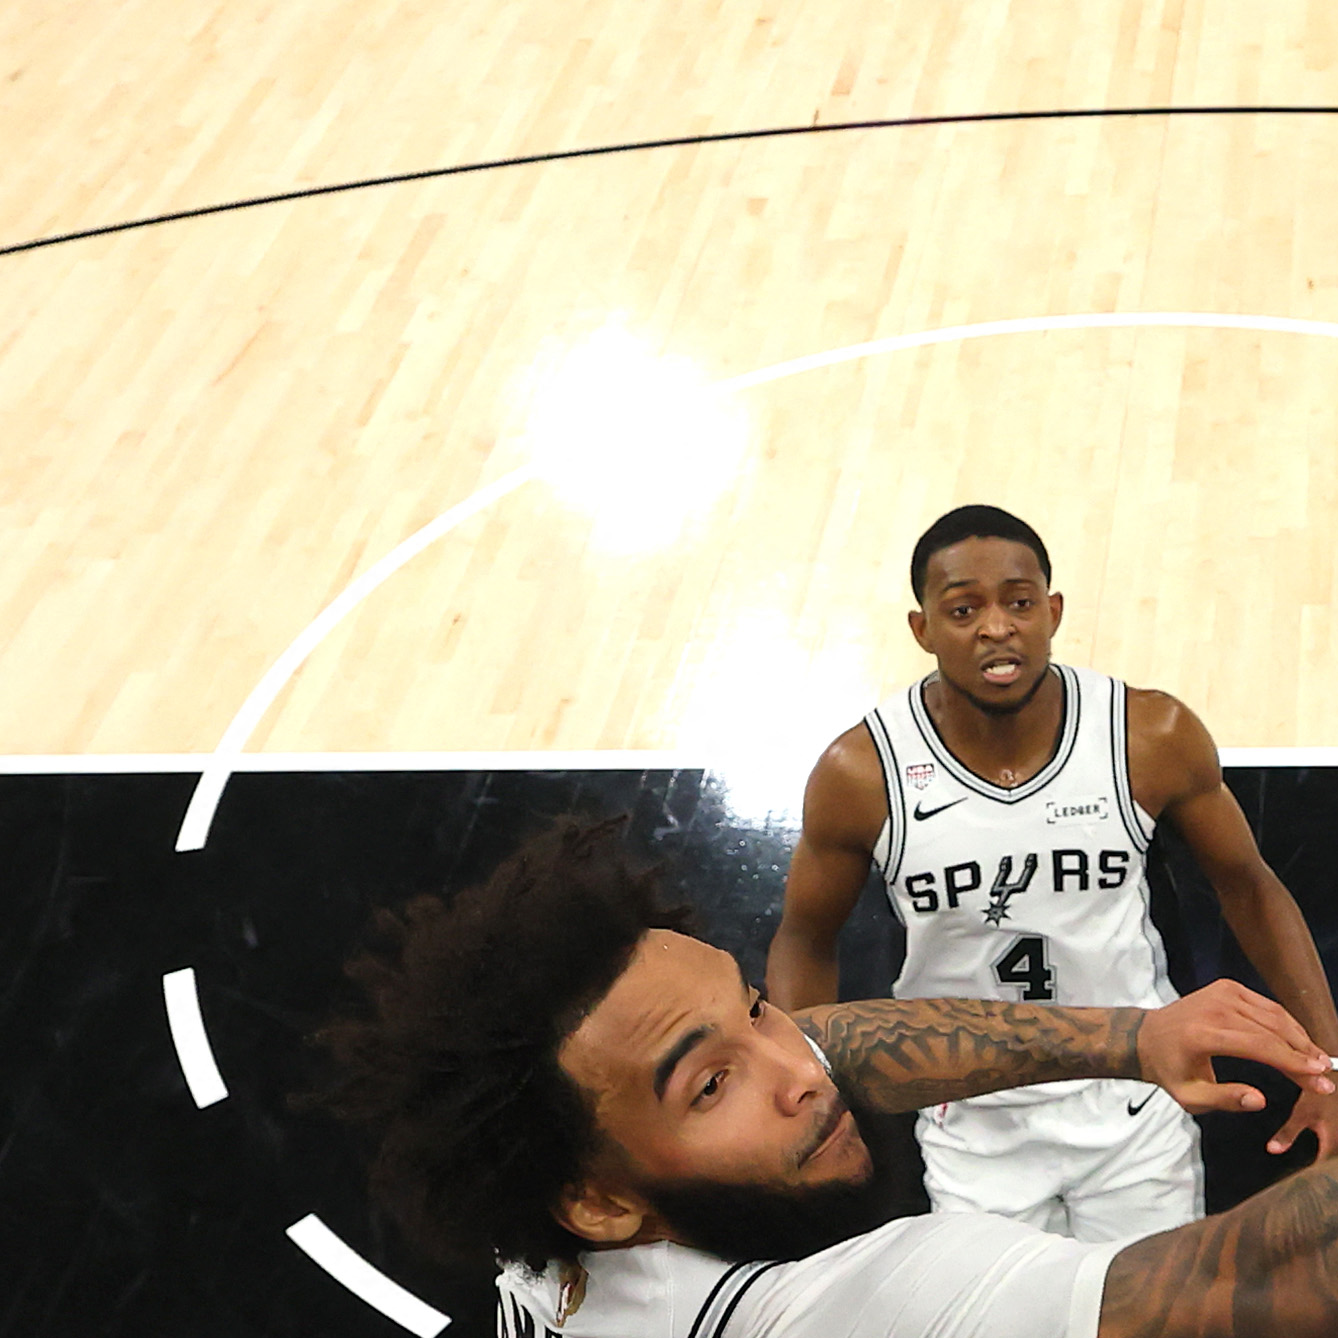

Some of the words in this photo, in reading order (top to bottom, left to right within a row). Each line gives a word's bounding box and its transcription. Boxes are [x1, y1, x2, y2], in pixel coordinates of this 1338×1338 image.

[1054, 803, 1100, 818] LEDGER
[905, 849, 1131, 926] SPURS
[989, 932, 1057, 1002] 4
